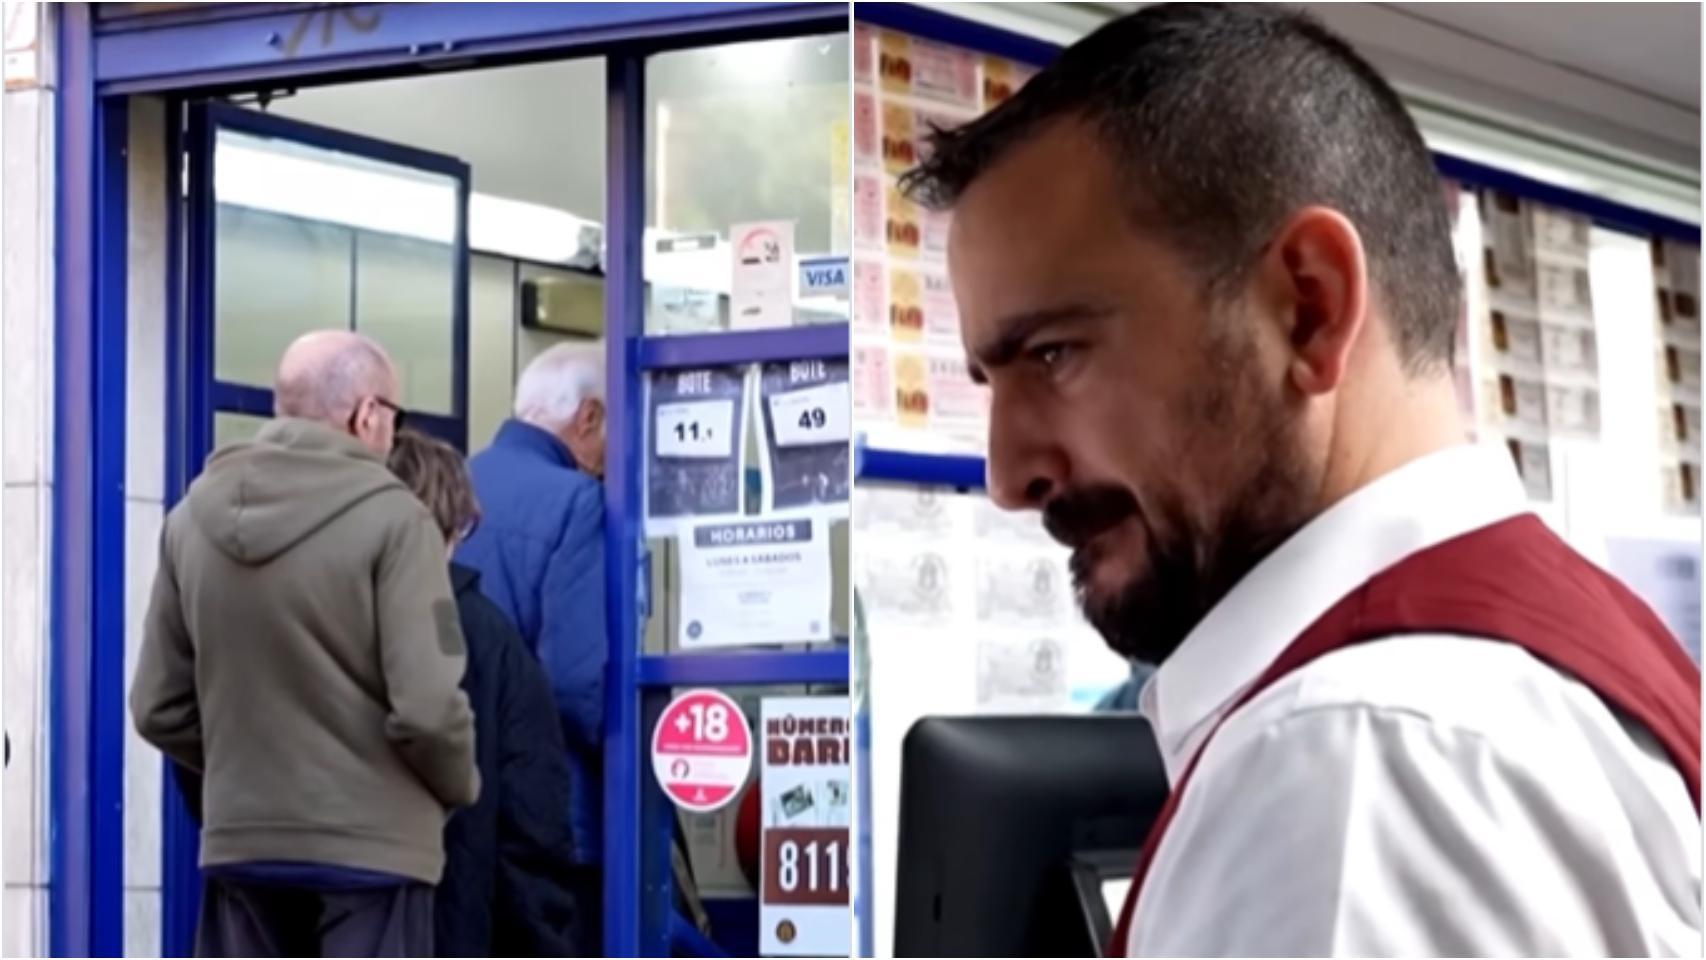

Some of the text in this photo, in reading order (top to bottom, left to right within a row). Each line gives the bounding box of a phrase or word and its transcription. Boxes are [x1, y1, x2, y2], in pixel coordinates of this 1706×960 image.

[807, 269, 845, 287] VISA
[798, 407, 826, 429] 49
[710, 525, 796, 544] HORARIOS
[673, 703, 729, 742] +18
[779, 840, 849, 892] 811
